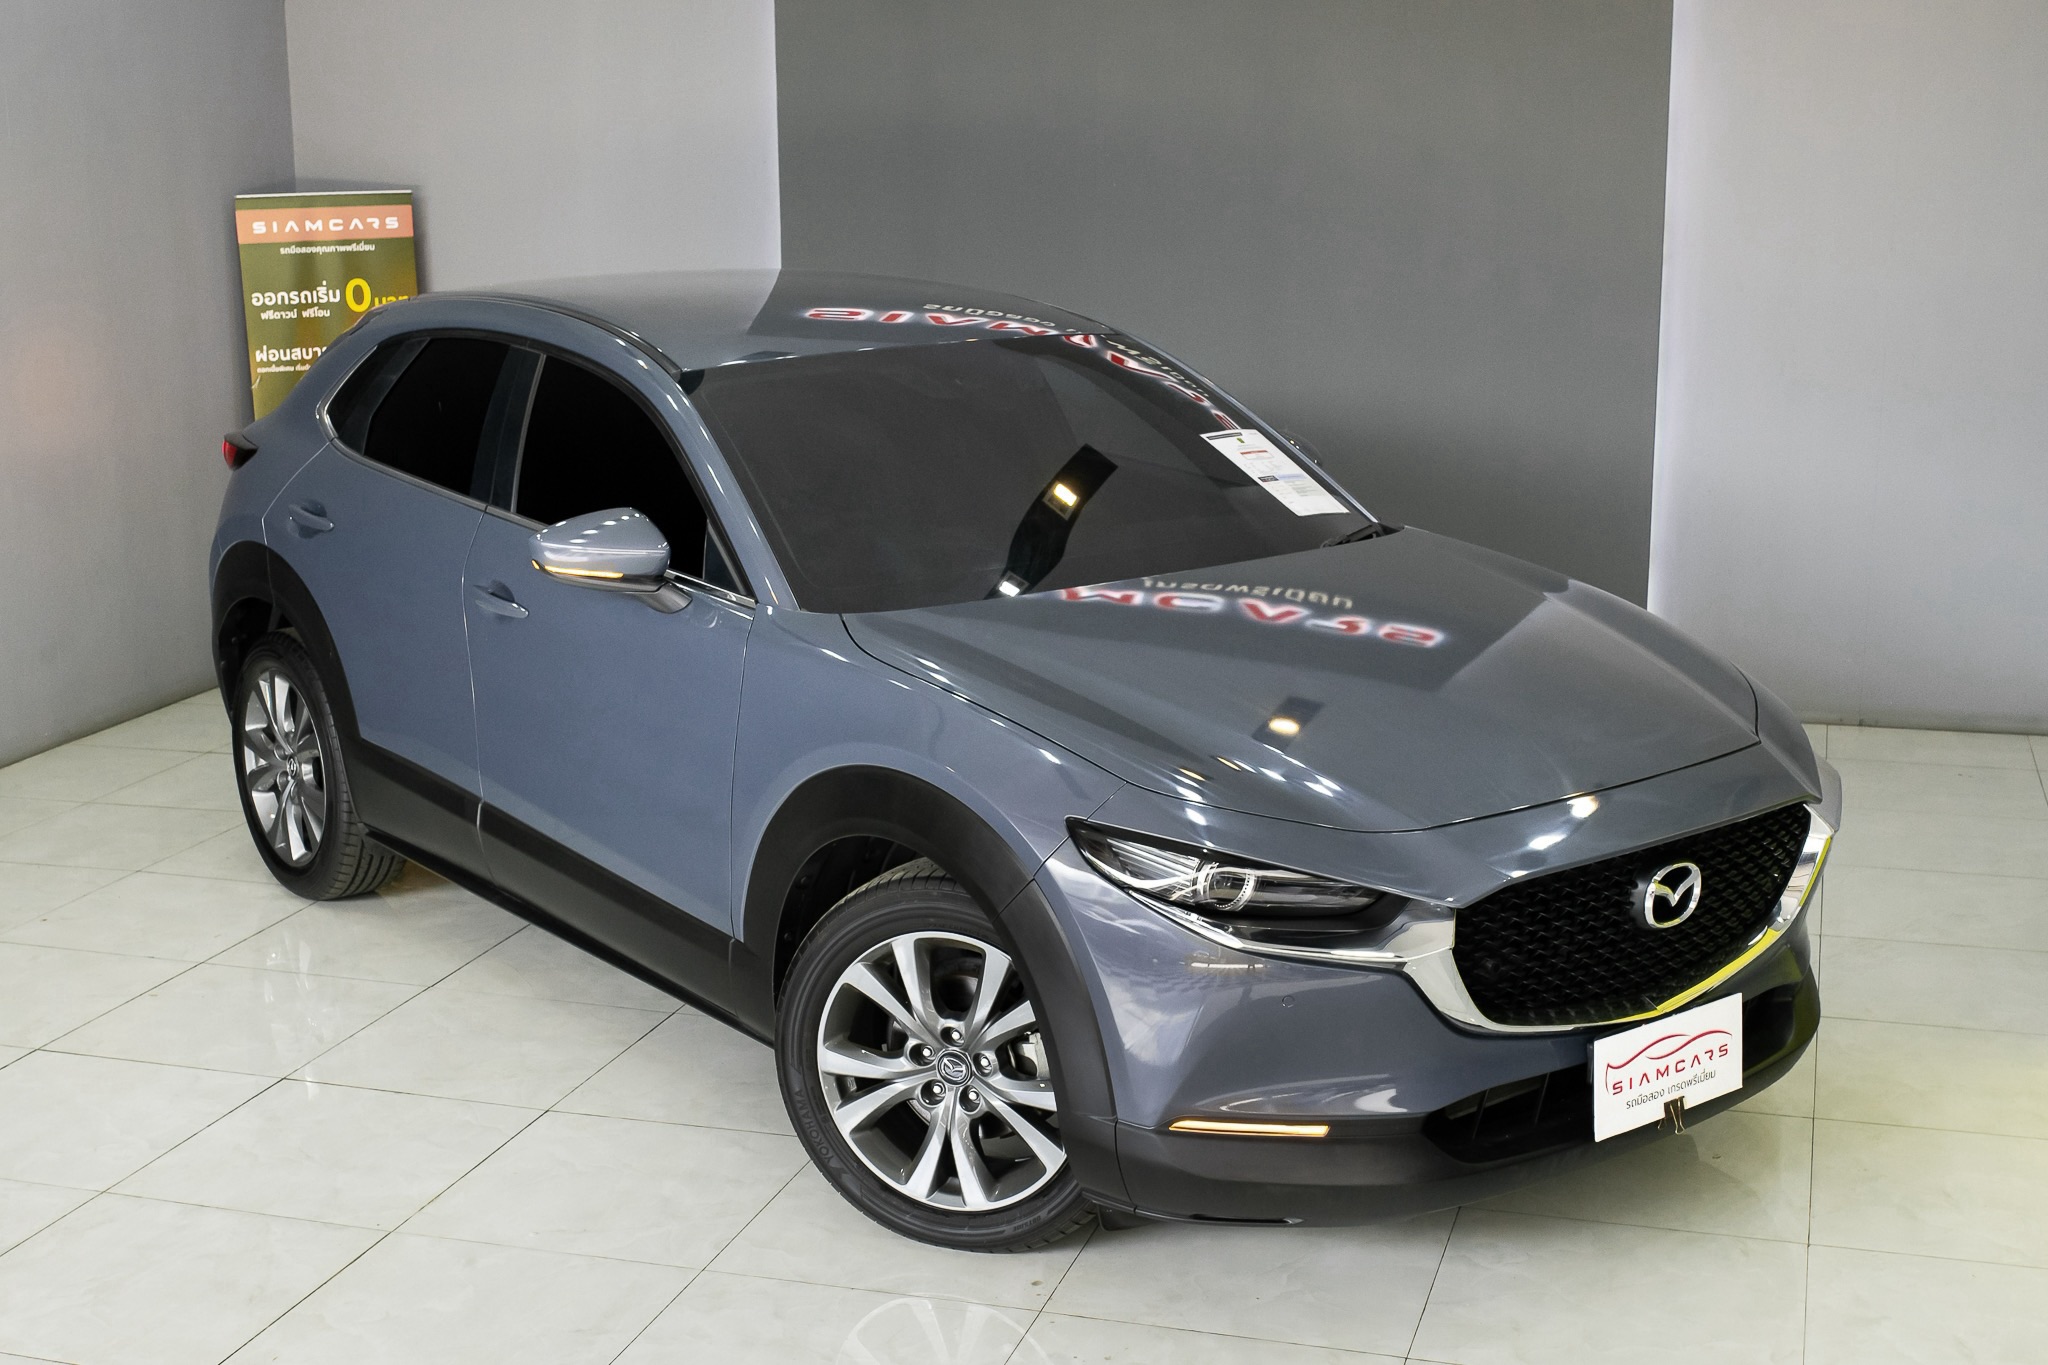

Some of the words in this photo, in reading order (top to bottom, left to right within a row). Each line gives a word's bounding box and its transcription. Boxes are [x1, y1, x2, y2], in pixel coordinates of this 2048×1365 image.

[252, 216, 399, 234] SIAMCARS
[251, 281, 341, 306] ออกรถเริ่ม
[345, 277, 372, 313] 0
[255, 345, 327, 363] ผ่อนสบา
[1612, 1043, 1729, 1096] SIAMCARS
[1626, 1087, 1665, 1110] รถมือสอง
[1667, 1069, 1717, 1095] เกรดพรีเมี่ยม
[794, 1088, 836, 1164] YOKOHAMA
